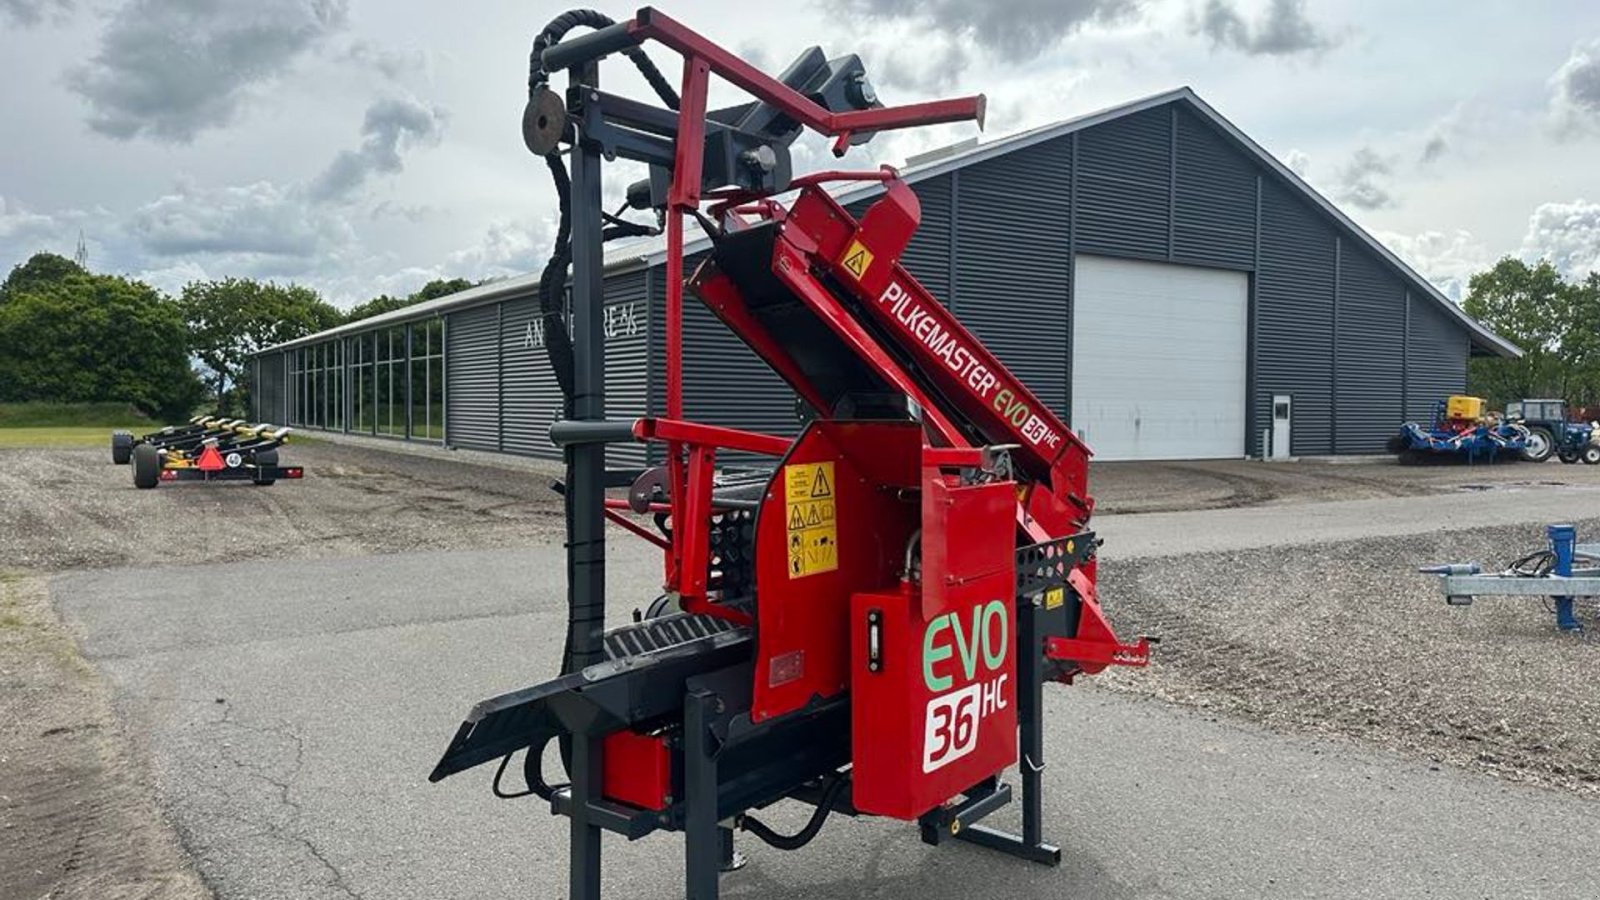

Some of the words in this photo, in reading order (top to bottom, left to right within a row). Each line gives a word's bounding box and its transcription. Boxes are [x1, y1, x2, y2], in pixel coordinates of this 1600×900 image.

[879, 281, 996, 397] PILKEMASTER
[993, 389, 1029, 428] EVO
[1023, 417, 1044, 442] 36
[1043, 429, 1061, 448] HC
[923, 600, 1008, 693] EVO
[930, 694, 974, 763] 36
[982, 673, 1008, 717] HC
